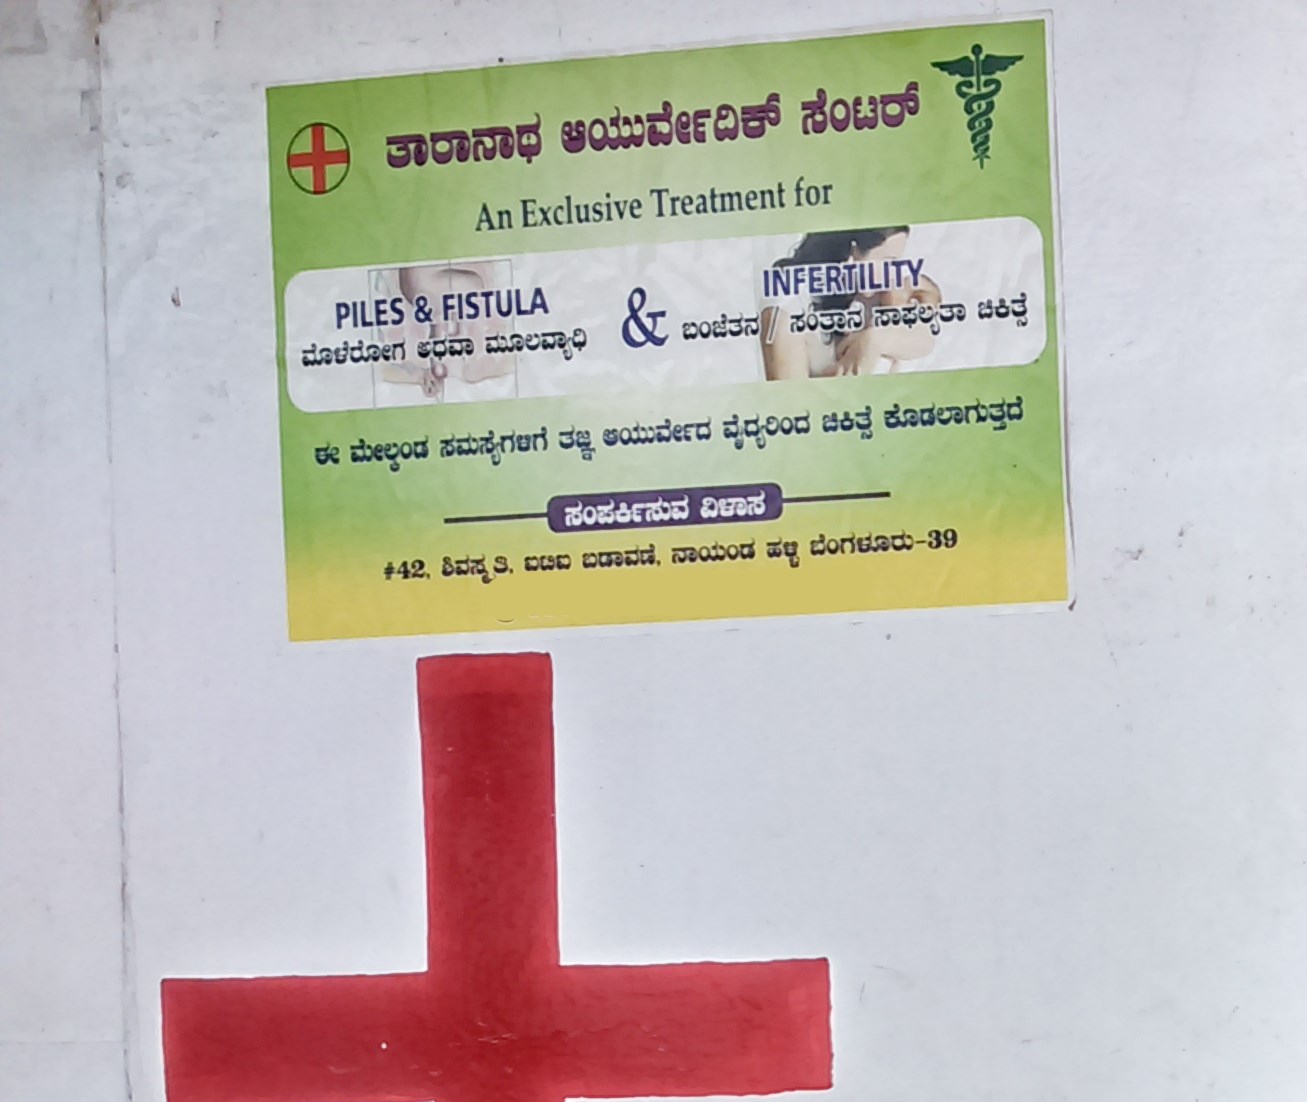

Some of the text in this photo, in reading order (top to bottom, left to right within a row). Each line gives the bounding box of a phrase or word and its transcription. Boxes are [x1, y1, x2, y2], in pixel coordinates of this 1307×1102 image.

[386, 81, 920, 168] ತಾರಾನಾಥ ಆಯುರ್ವೇದಿಕ್ ಸೆಂಟರ್
[475, 176, 832, 232] An Exclusive Treatment for
[763, 258, 925, 297] INFERTILITY
[335, 287, 550, 329] PILES & FISTULA
[621, 287, 669, 348] &
[682, 312, 760, 341] ಬಂಜೆತನ
[790, 303, 863, 334] ಸಂತಾನ
[874, 301, 966, 335] ಸಾಫಲ್ಯತಾ
[977, 292, 1029, 327] ಚಿಕಿತ್ಸೆ
[485, 327, 587, 361] ಮೂಲವ್ಯಾಧಿ
[315, 395, 1024, 472] ಈ ಮೇಲ್ಕಂಡ ಸಮಸ್ಯೆಗಳಿಗೆ ತಜ್ಞ ಆಯುರ್ವೇದ ವೈದ್ಯರಿಂದ ಚಿಕಿತ್ಸೆ ಕೊಡಲಾಗುತ್ತದೆ
[564, 490, 766, 527] ಸಂಪರ್ಕಿಸುವ ವಿಳಾಸ
[384, 558, 430, 580] #42,
[672, 538, 755, 565] ನಾಯಂಡ
[767, 537, 800, 568] ಹಳ್ಳಿ
[810, 528, 957, 555] ಬೆಂಗಳೂರು-39
